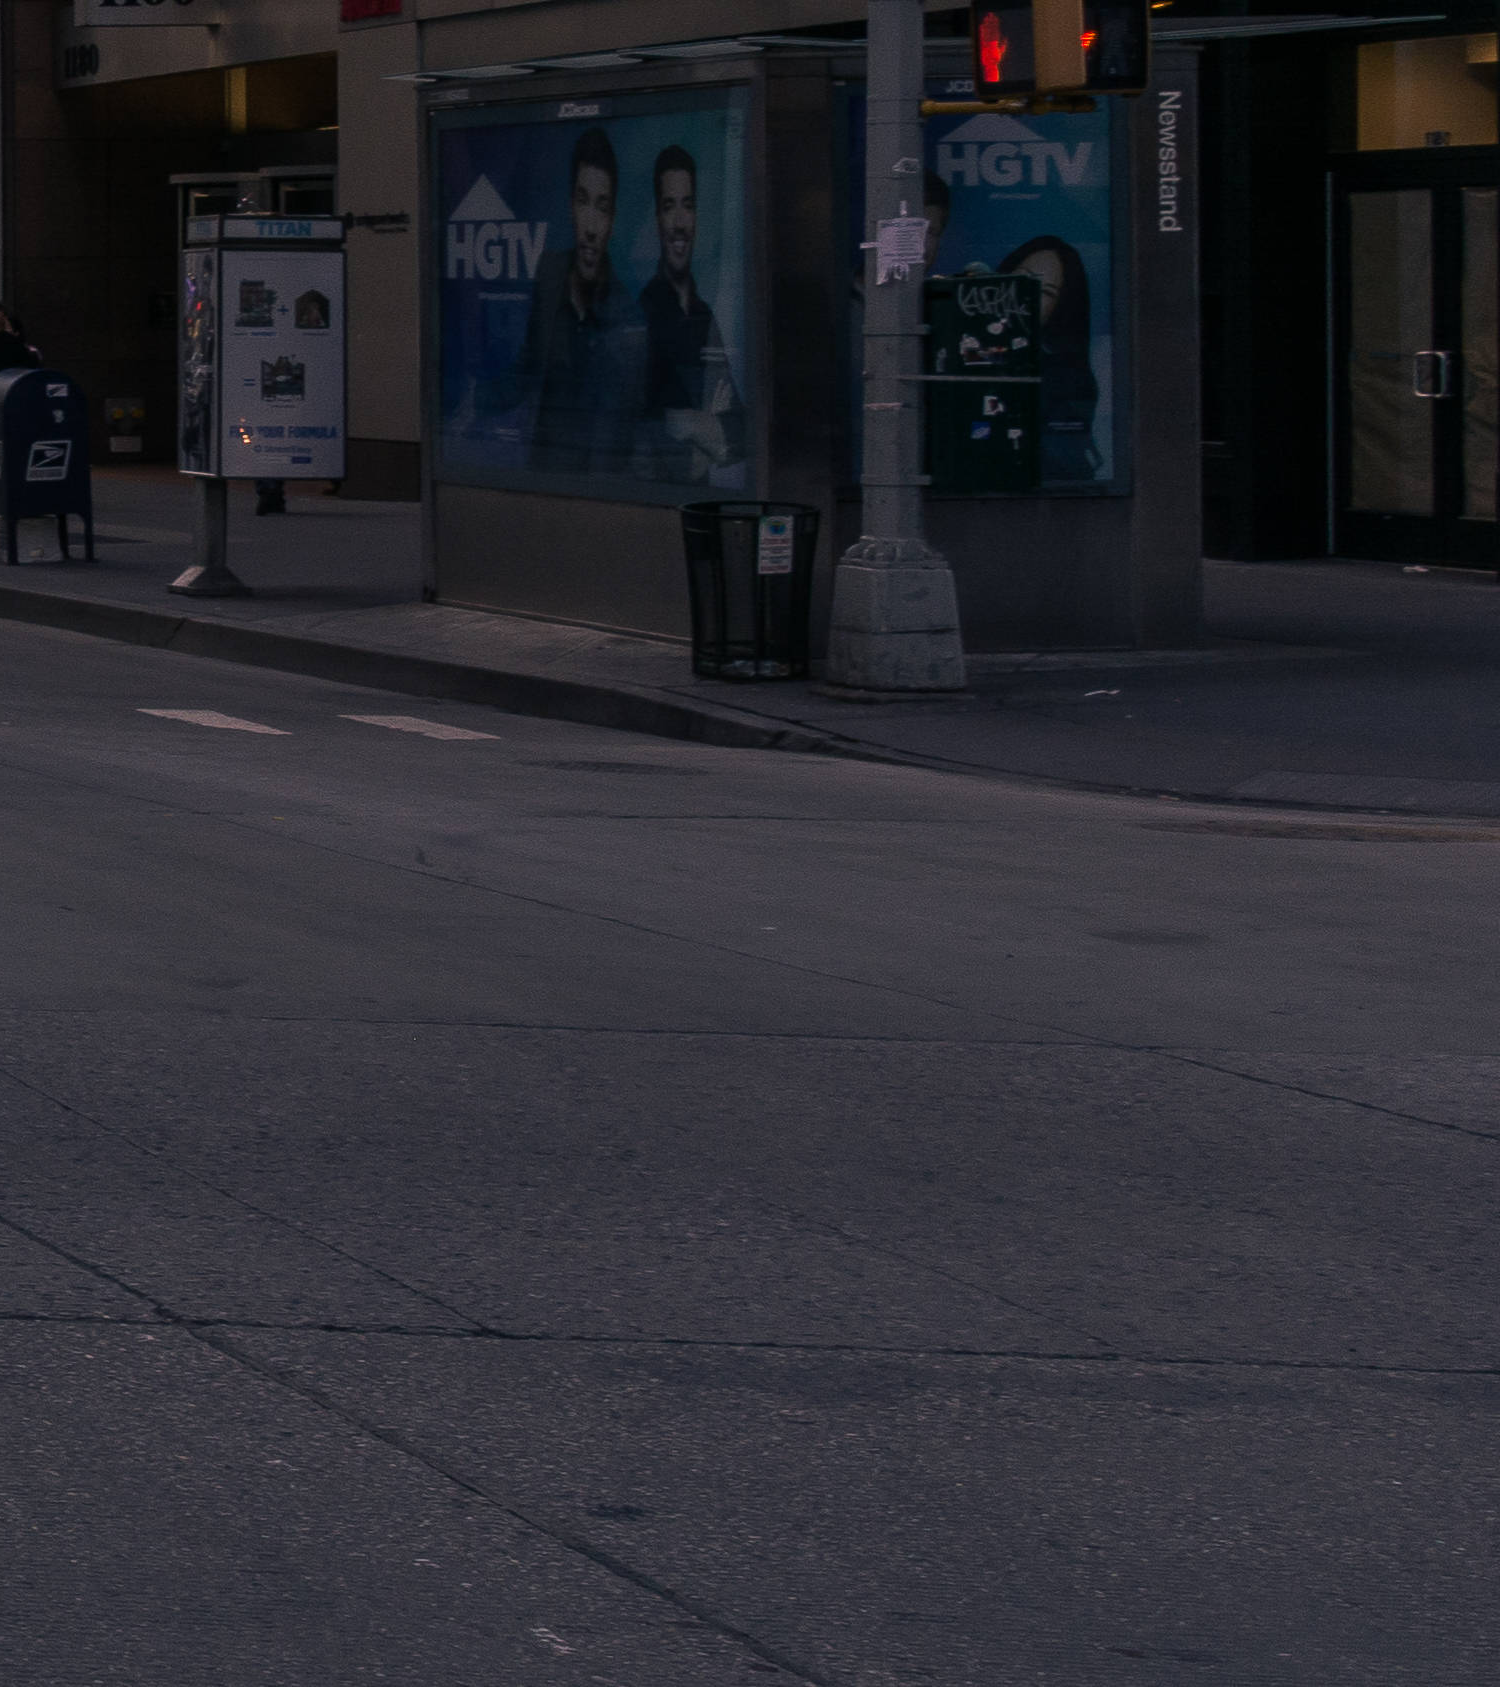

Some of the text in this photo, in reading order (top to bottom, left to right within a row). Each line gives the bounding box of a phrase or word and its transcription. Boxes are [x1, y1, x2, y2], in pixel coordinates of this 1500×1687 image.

[64, 44, 98, 78] 1180
[936, 142, 1092, 187] HGTV
[1158, 91, 1183, 232] Newsstand
[256, 222, 312, 236] TITAN
[447, 222, 549, 281] HGTV
[257, 425, 284, 439] YOUR
[288, 425, 337, 439] FORMULA
